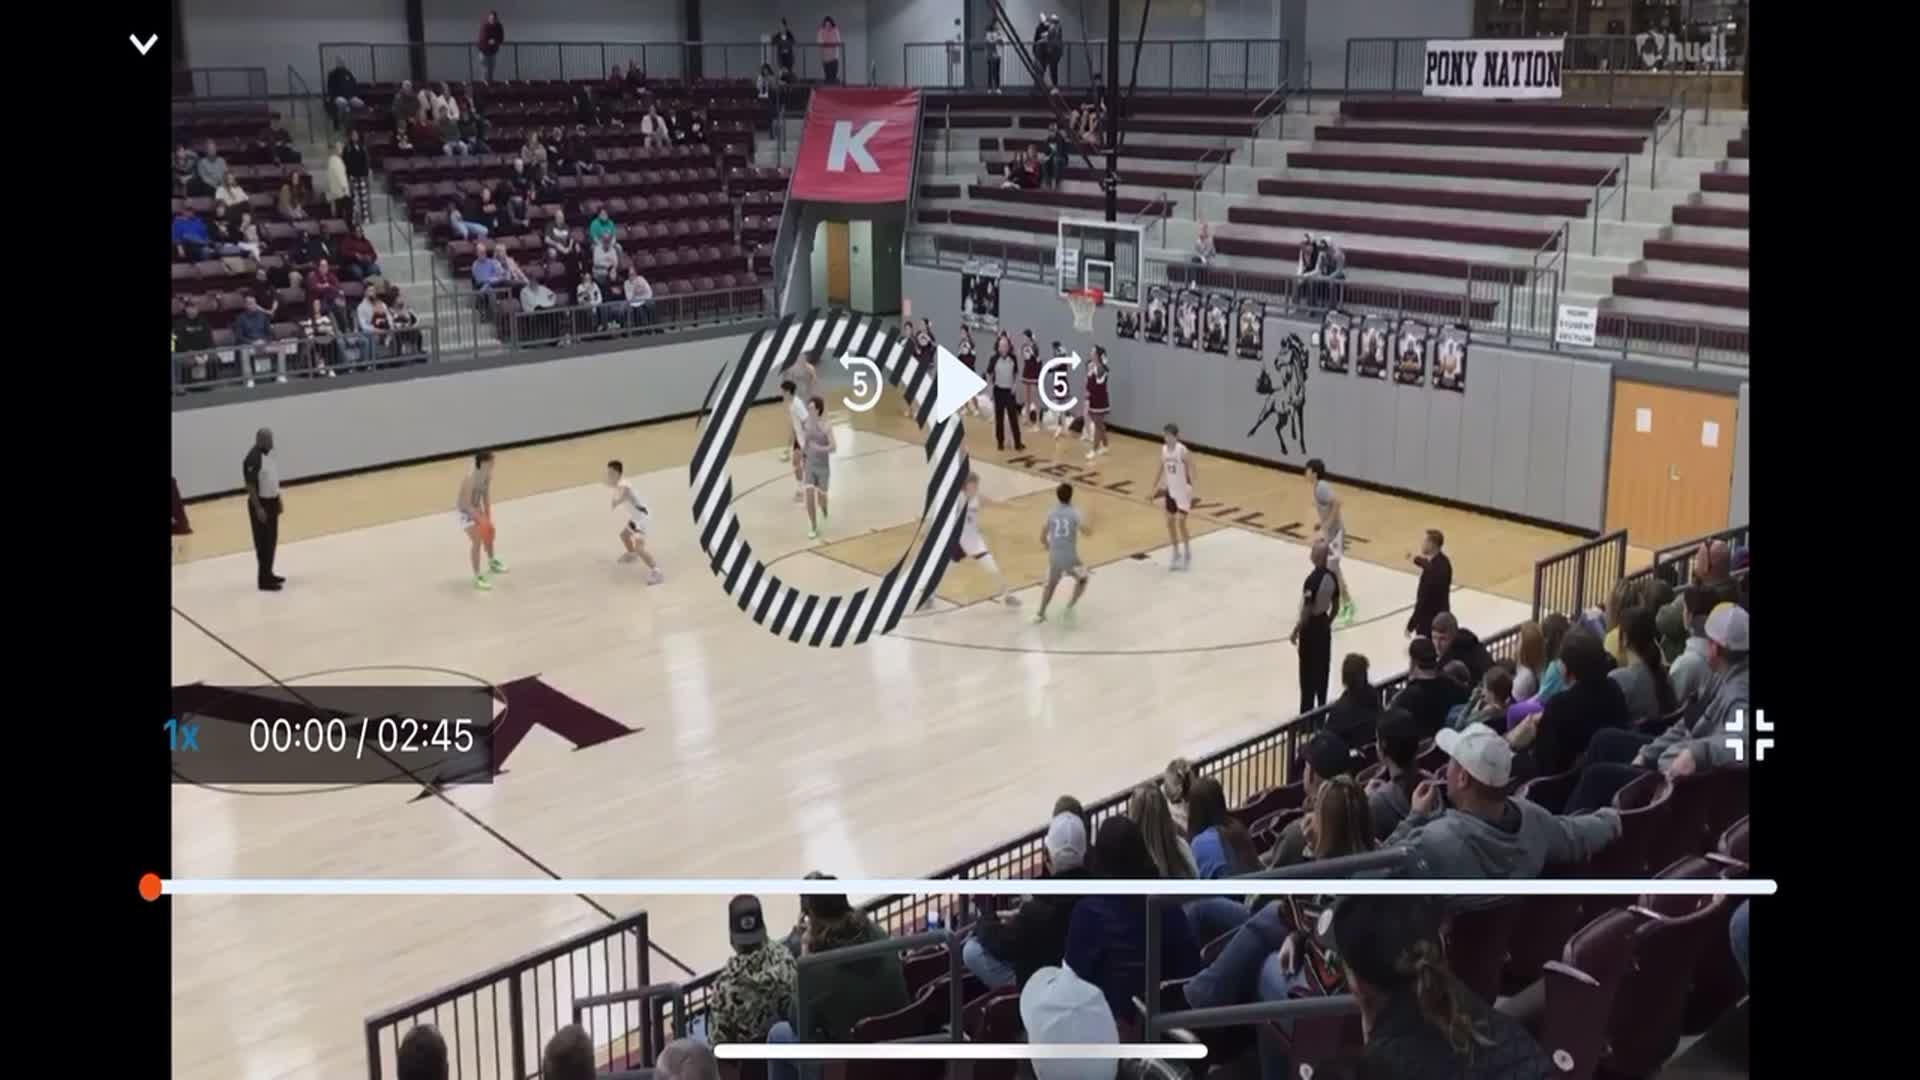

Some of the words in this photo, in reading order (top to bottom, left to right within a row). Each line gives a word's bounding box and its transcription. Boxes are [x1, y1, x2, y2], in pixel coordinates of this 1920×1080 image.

[1425, 50, 1478, 87] PONY
[1482, 50, 1563, 88] NATION
[826, 119, 888, 173] K
